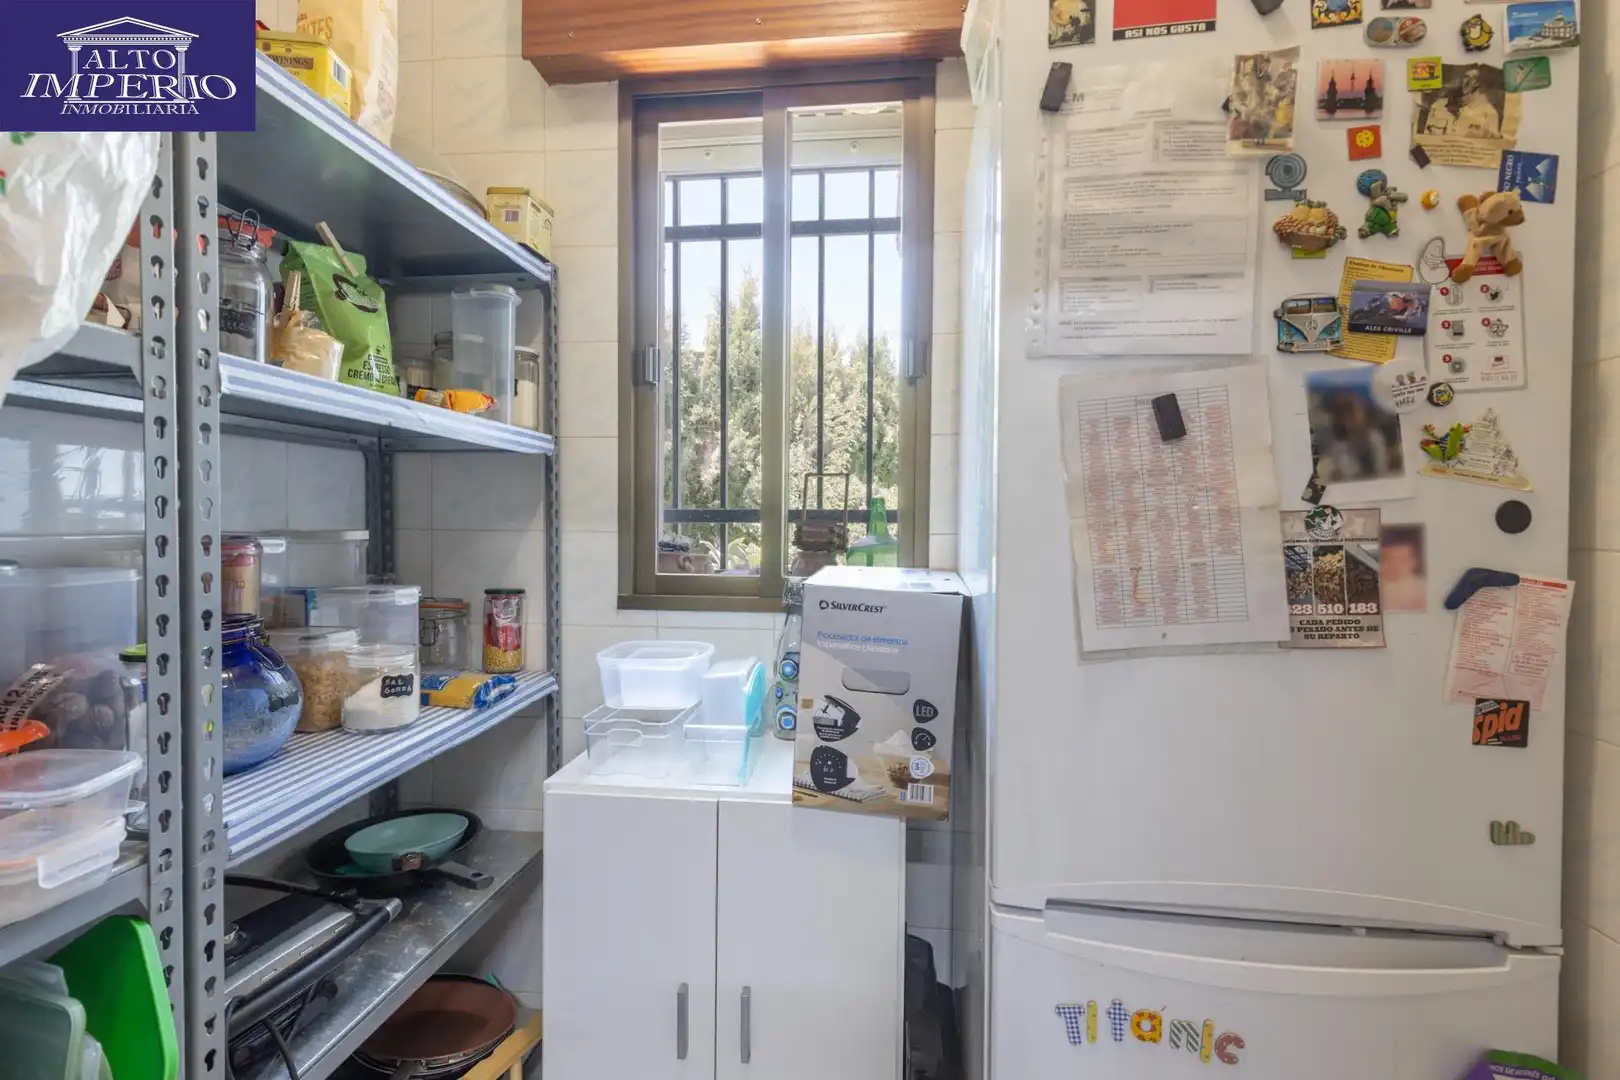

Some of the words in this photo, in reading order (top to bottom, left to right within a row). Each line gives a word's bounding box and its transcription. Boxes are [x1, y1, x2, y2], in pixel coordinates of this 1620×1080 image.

[1145, 26, 1168, 36] NOS
[1170, 22, 1206, 34] GUSTA
[363, 361, 390, 374] ESRESSO
[1290, 604, 1313, 615] 23
[1317, 603, 1344, 614] 510
[1349, 602, 1378, 614] 183
[915, 705, 934, 718] LED
